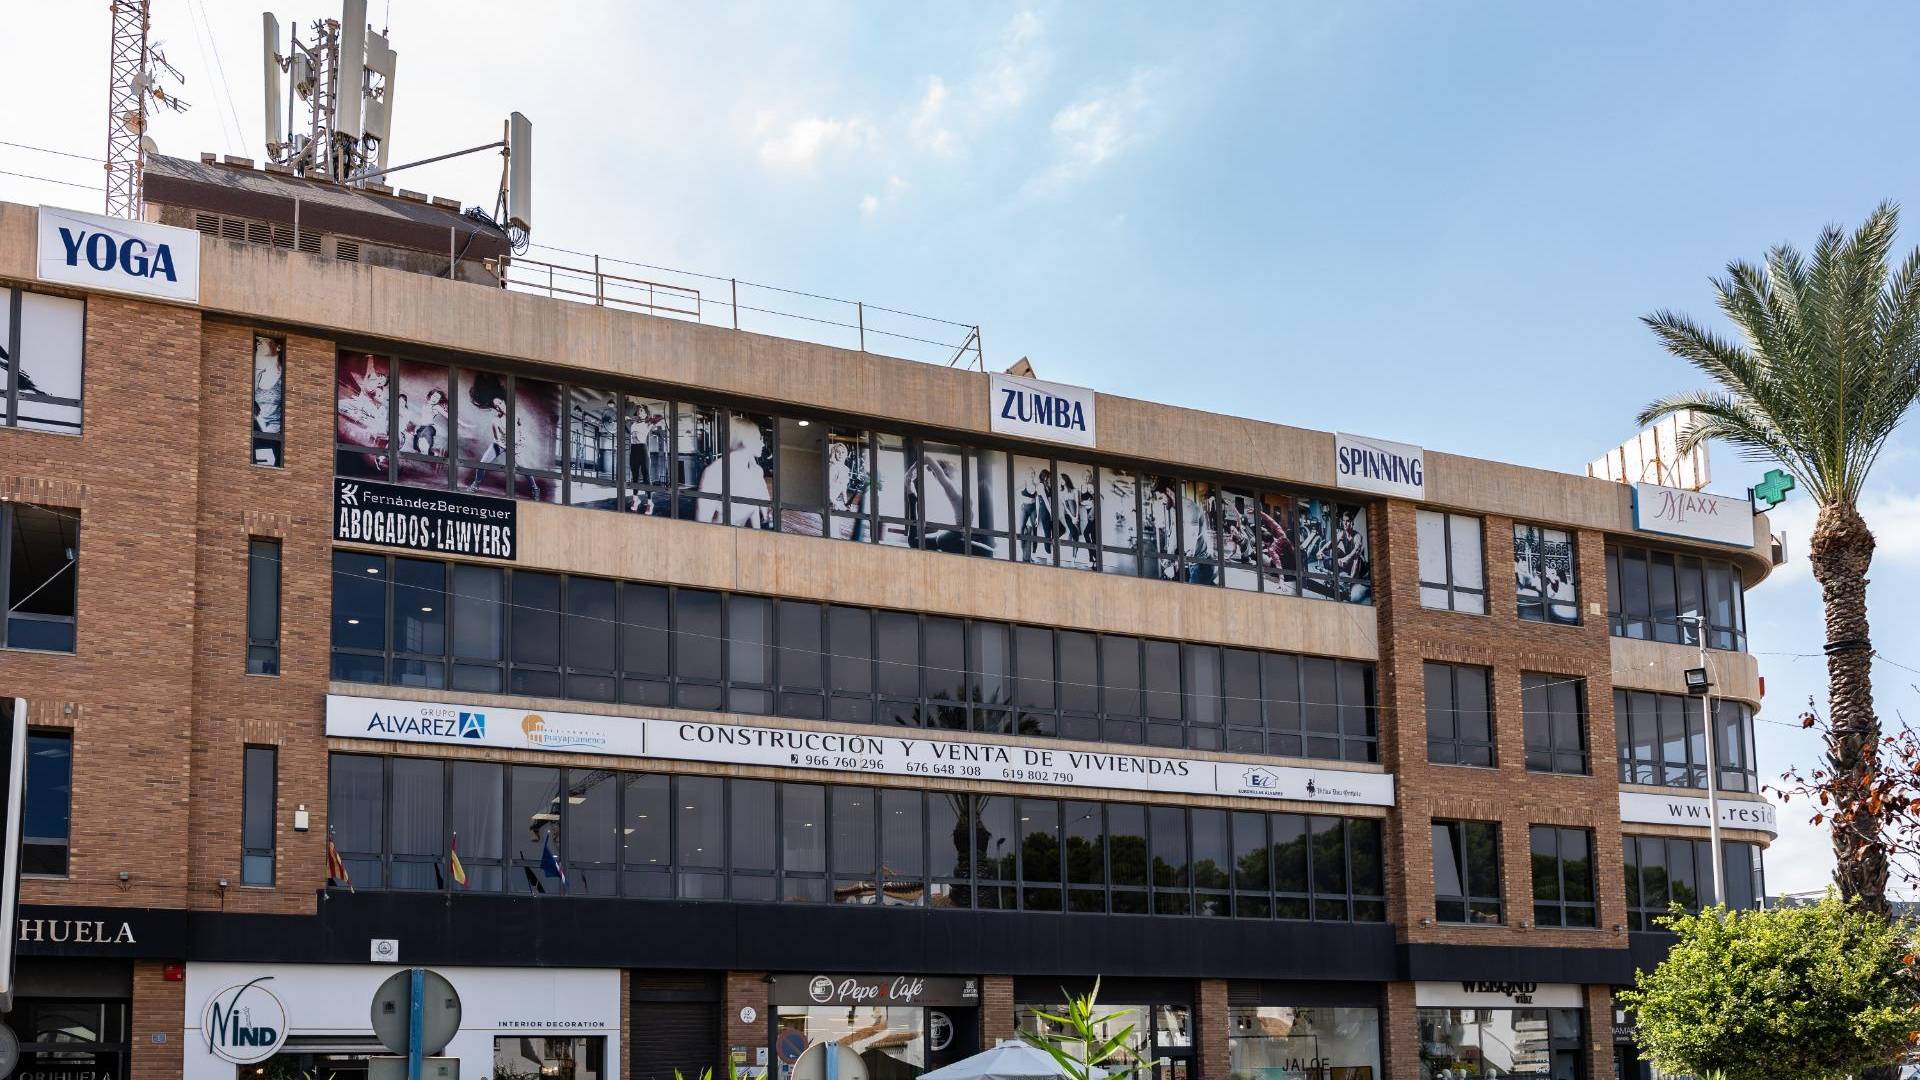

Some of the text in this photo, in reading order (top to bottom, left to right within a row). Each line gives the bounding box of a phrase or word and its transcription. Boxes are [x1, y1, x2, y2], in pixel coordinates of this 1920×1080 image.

[59, 227, 177, 282] YOGA
[1001, 388, 1086, 431] ZUMBA
[1339, 446, 1423, 487] SPINNING
[366, 711, 457, 737] ALVAREZ
[421, 708, 456, 718] GRUPO
[679, 724, 1190, 776] CONSTRUCCIÓN Y VENTA DE VIVIENDAS
[805, 755, 1074, 783] 966 760 296 676 648 308 619 802 790
[18, 919, 137, 943] HUELA
[837, 978, 879, 1002] Pepe
[889, 975, 925, 1003] Café
[498, 1020, 605, 1028] INTERIOR DECORATION
